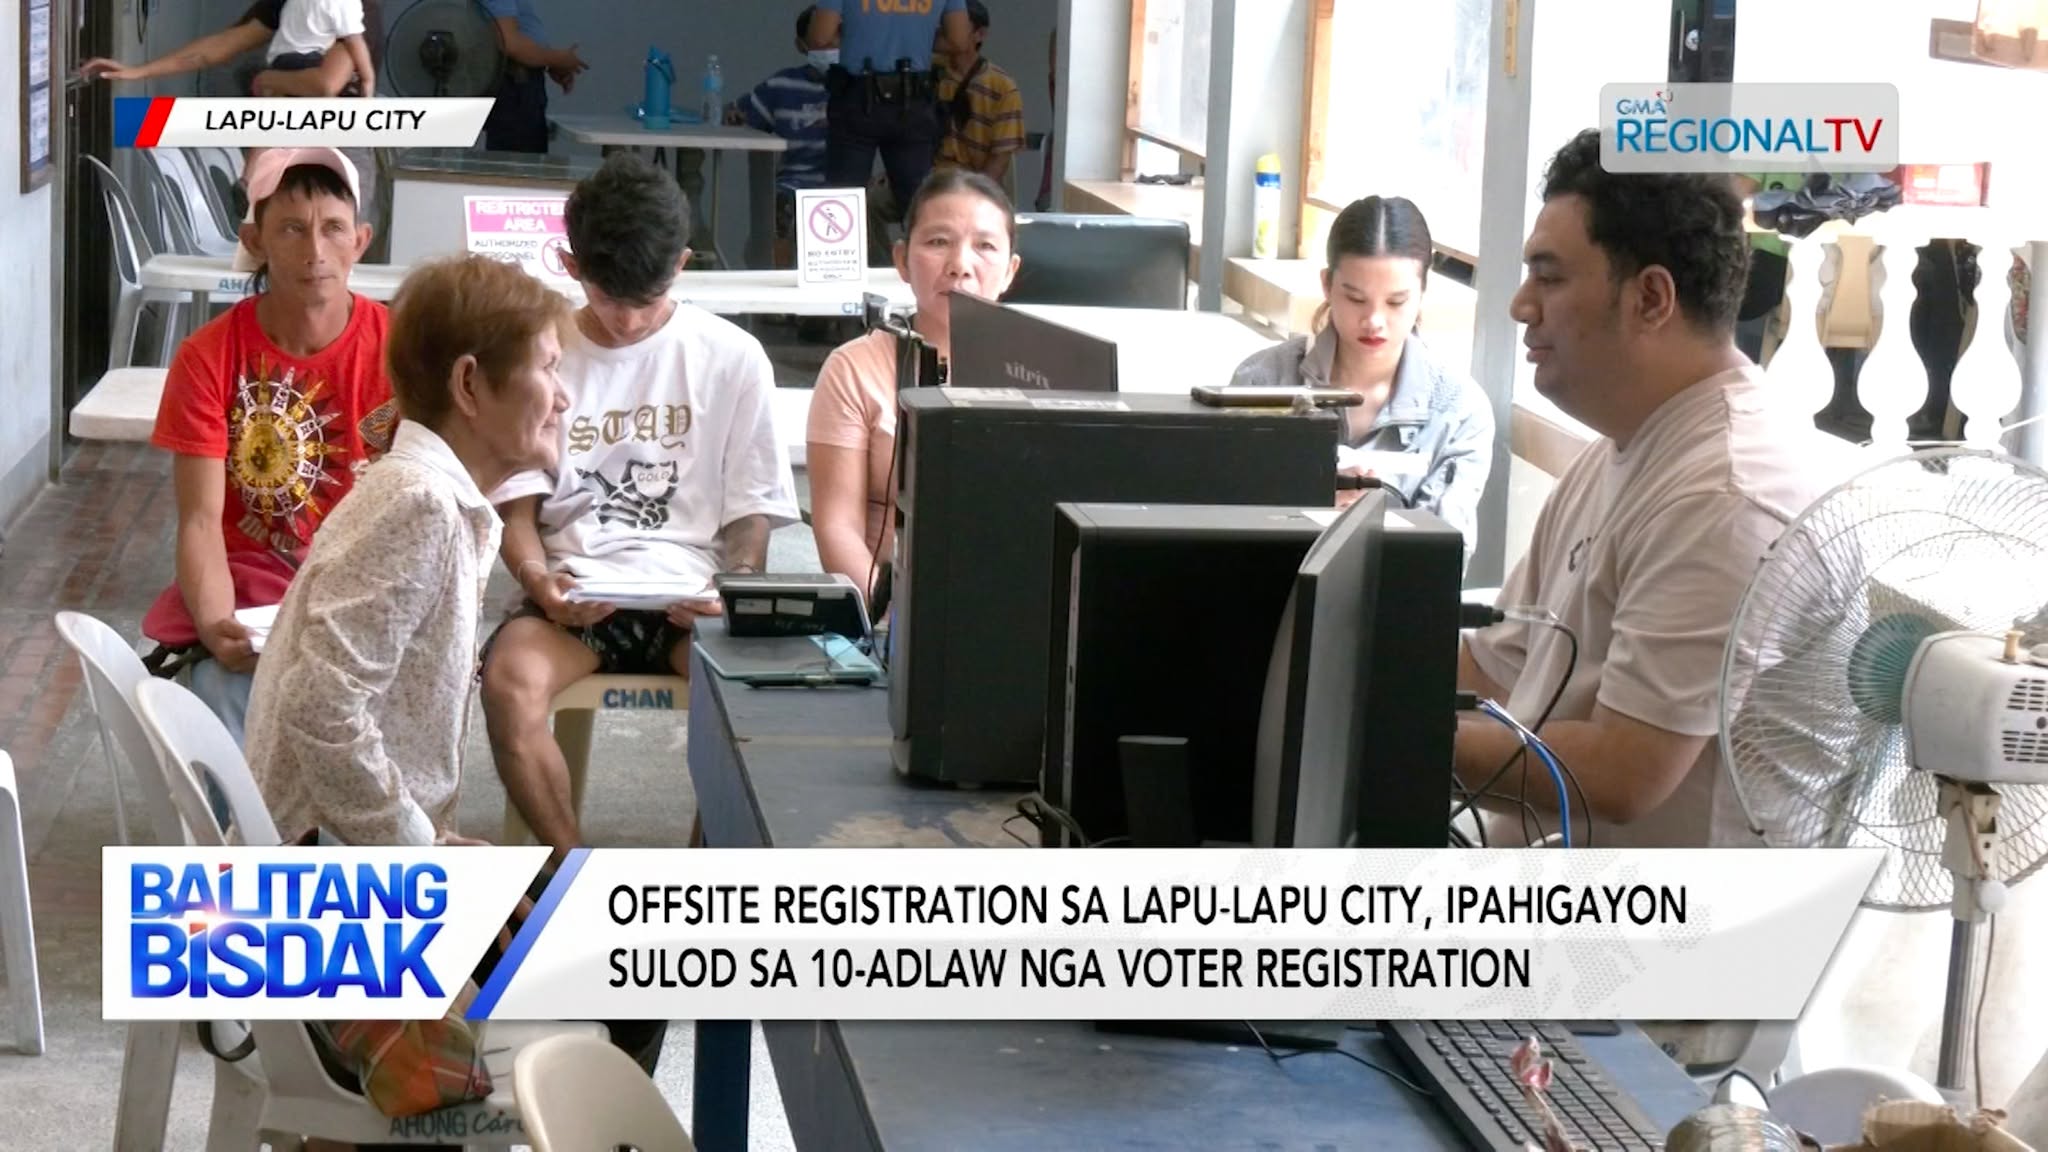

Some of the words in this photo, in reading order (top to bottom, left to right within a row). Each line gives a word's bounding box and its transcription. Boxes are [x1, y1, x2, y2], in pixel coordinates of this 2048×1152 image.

[475, 201, 565, 216] RESTRICTE
[503, 217, 547, 232] AREA
[567, 404, 692, 456] STAY
[603, 688, 673, 708] CHAN
[389, 1110, 467, 1137] AHONG
